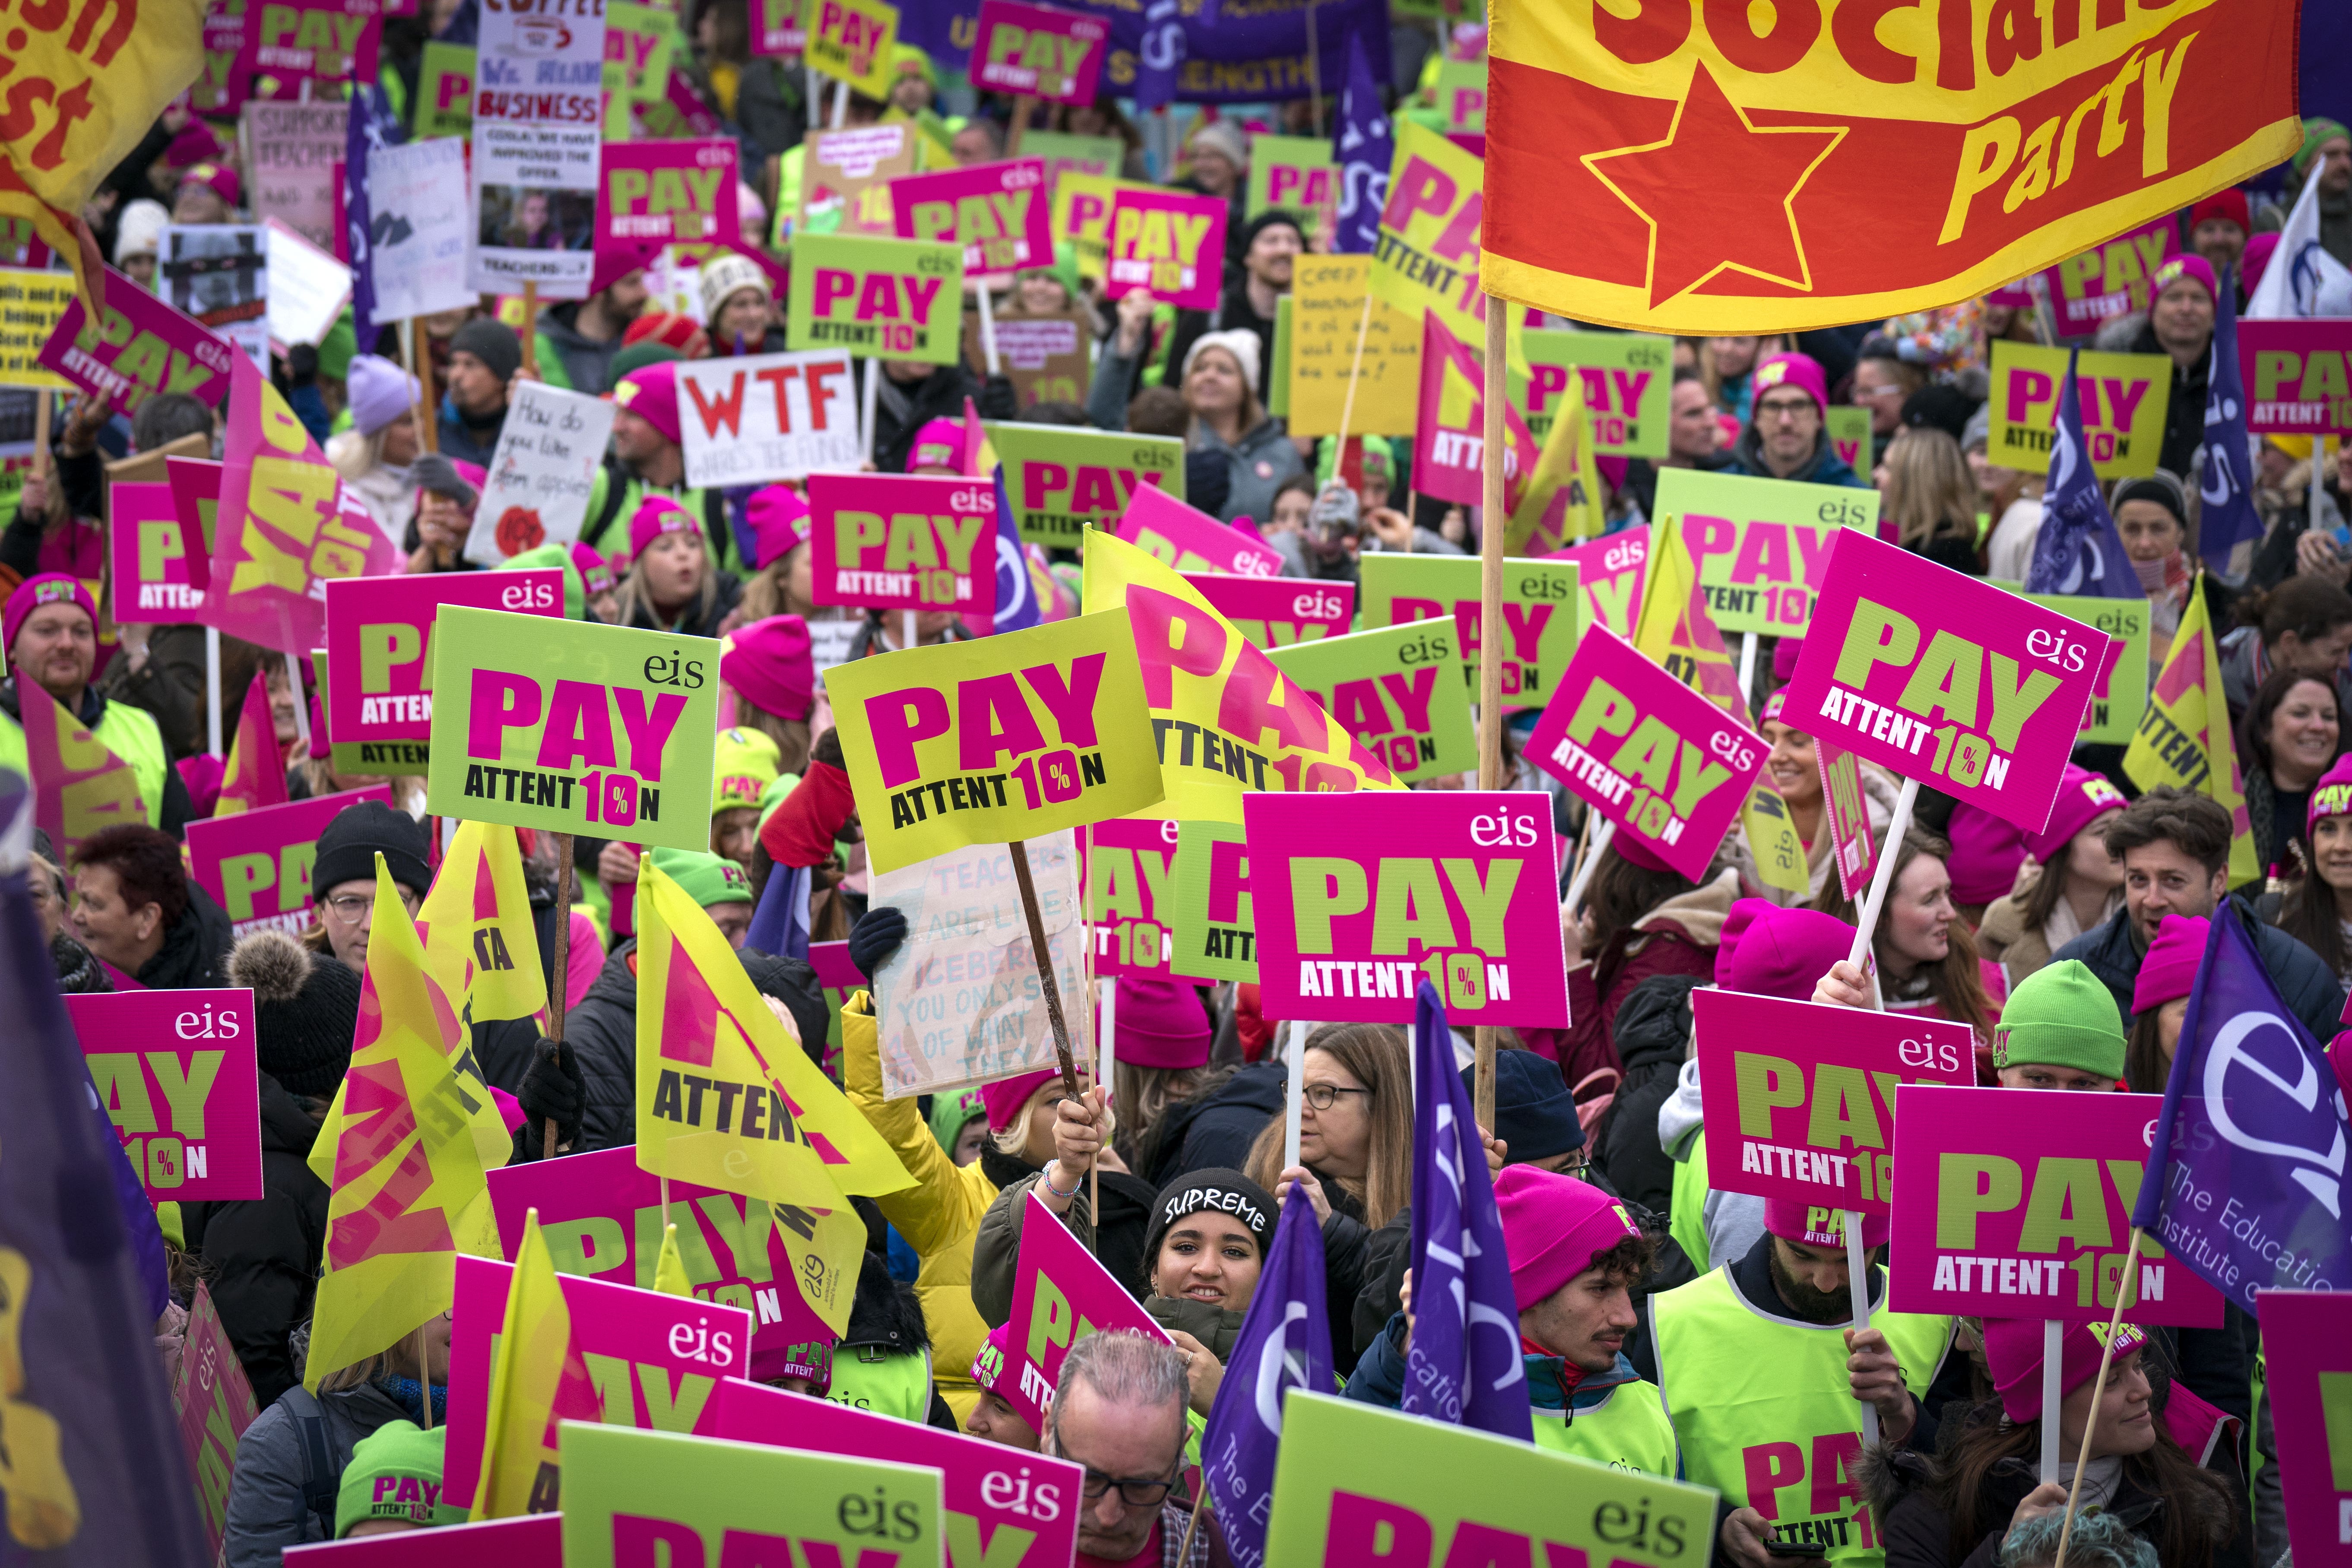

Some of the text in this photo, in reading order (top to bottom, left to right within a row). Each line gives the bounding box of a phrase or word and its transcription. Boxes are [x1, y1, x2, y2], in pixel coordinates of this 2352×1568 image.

[260, 4, 368, 54] PAY
[817, 1, 888, 63] PAY
[987, 22, 1094, 76] PAY
[478, 91, 597, 123] BUSINESS
[695, 144, 732, 166] eis
[1937, 30, 2200, 246] Party
[607, 167, 724, 216] PAY
[1000, 168, 1042, 189] eis
[910, 189, 1033, 252] PAY
[1112, 207, 1214, 263] PAY
[917, 252, 957, 274] eis
[2057, 226, 2168, 300] PAY
[812, 268, 945, 325] PAY
[73, 305, 215, 396] PAY
[1627, 345, 1665, 367] eis
[684, 361, 846, 440] WTF
[1527, 363, 1653, 418] PAY
[1132, 445, 1174, 469] eis
[950, 486, 995, 513] eis
[1818, 497, 1866, 526] eis
[834, 510, 985, 574] PAY
[1604, 539, 1645, 571] eis
[501, 578, 555, 610] eis
[1292, 589, 1344, 621] eis
[1521, 573, 1567, 599] eis
[2095, 609, 2140, 637] eis
[643, 649, 706, 690] eis
[1399, 635, 1449, 665] eis
[1832, 596, 2065, 754] PAY
[2026, 628, 2088, 673] eis
[467, 668, 690, 783] PAY
[863, 652, 1108, 790] PAY
[1566, 675, 1734, 821] PAY
[1709, 730, 1757, 773] eis
[720, 776, 763, 795] PAY
[1469, 805, 1538, 847] eis
[219, 839, 318, 922] PA
[932, 845, 1067, 896] TEACERS
[1078, 845, 1177, 928] AY
[926, 888, 1062, 944] ARE LIE
[1288, 856, 1525, 958] PAY
[896, 966, 1077, 1026] YOU ONLY SE
[175, 1003, 241, 1040] eis
[922, 1009, 1031, 1059] OF WHAT
[956, 1043, 1033, 1083] THEY
[1898, 1033, 1959, 1073] eis
[86, 1049, 226, 1140] AY
[1164, 1188, 1267, 1233] SUPREME
[1936, 1152, 2167, 1258] PAY
[2171, 1158, 2212, 1213] The
[669, 1317, 733, 1366] eis
[786, 1341, 831, 1371] PAY
[1222, 1431, 1248, 1499] The
[1742, 1431, 1867, 1521] PA
[372, 1477, 443, 1507] PAY
[837, 1486, 922, 1544] eis
[980, 1469, 1061, 1523] eis
[1593, 1497, 1687, 1558] eis
